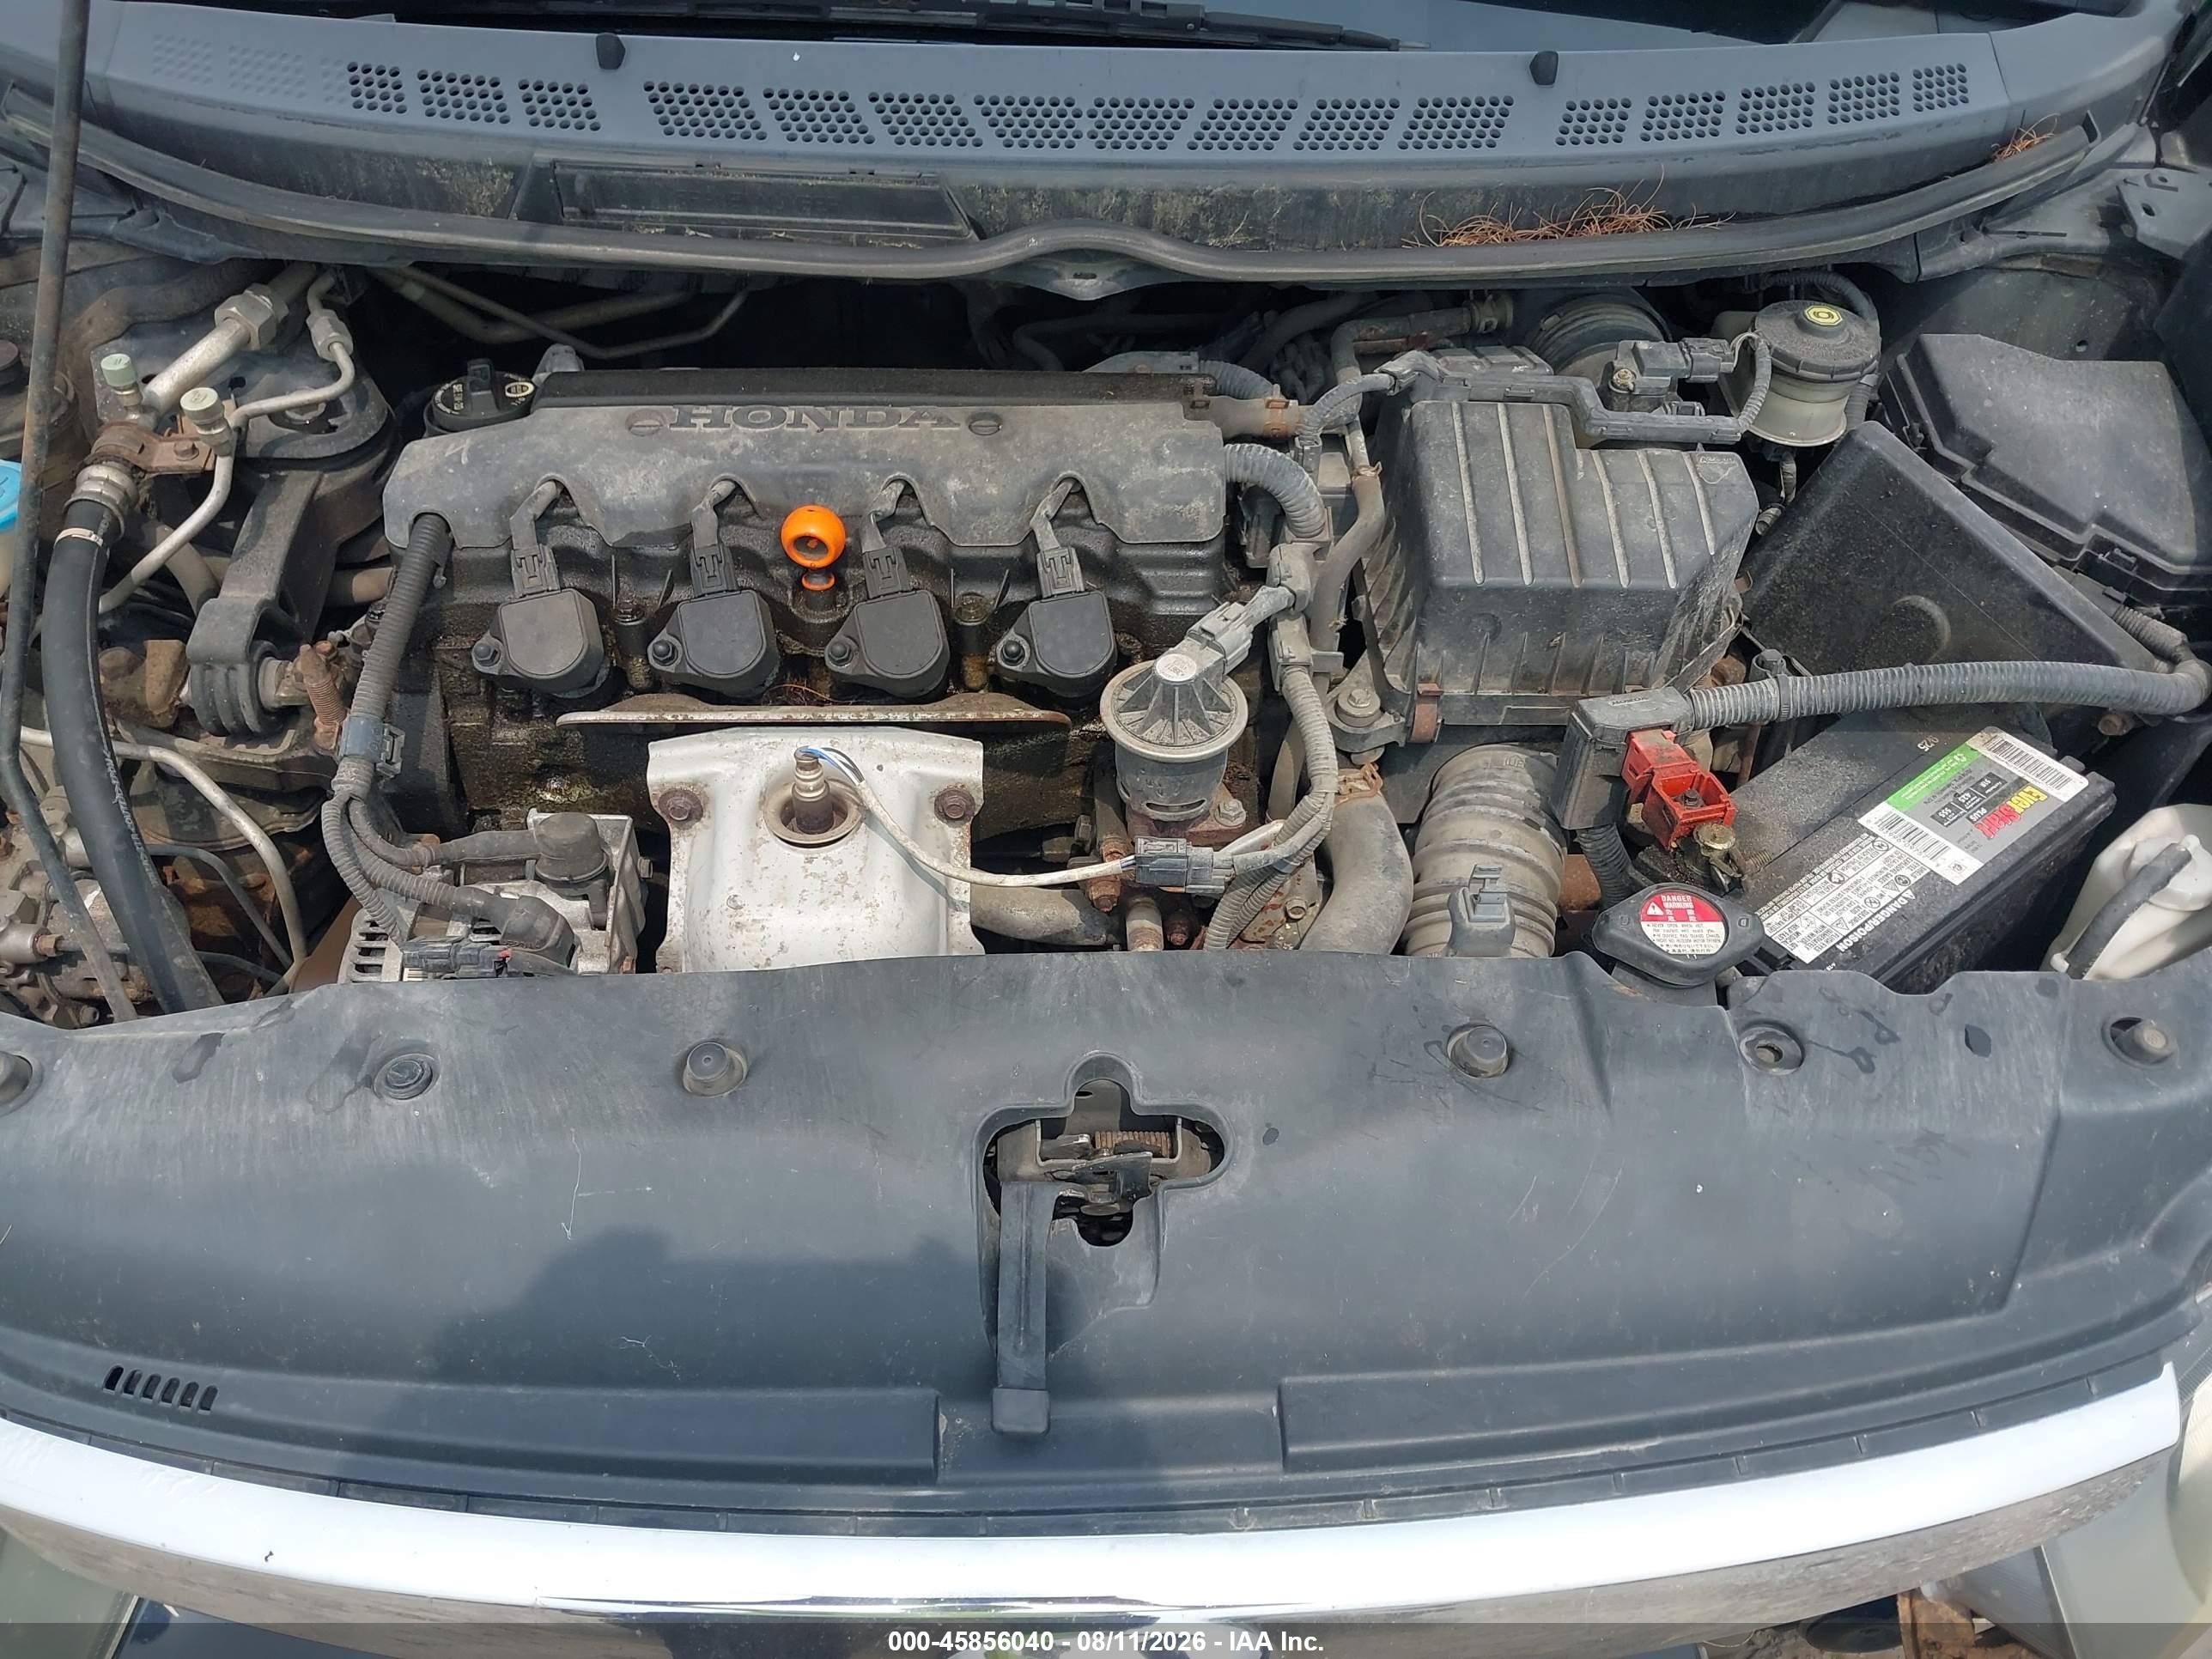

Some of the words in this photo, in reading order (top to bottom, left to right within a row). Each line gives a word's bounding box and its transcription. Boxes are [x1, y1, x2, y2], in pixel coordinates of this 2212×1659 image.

[669, 404, 961, 432] HONDA
[1956, 791, 1973, 803] 425
[1936, 805, 1953, 818] 555
[1966, 806, 1989, 822] PLUS
[1835, 896, 1908, 954] DANGER/POISON
[1780, 929, 1802, 948] MEDICAL
